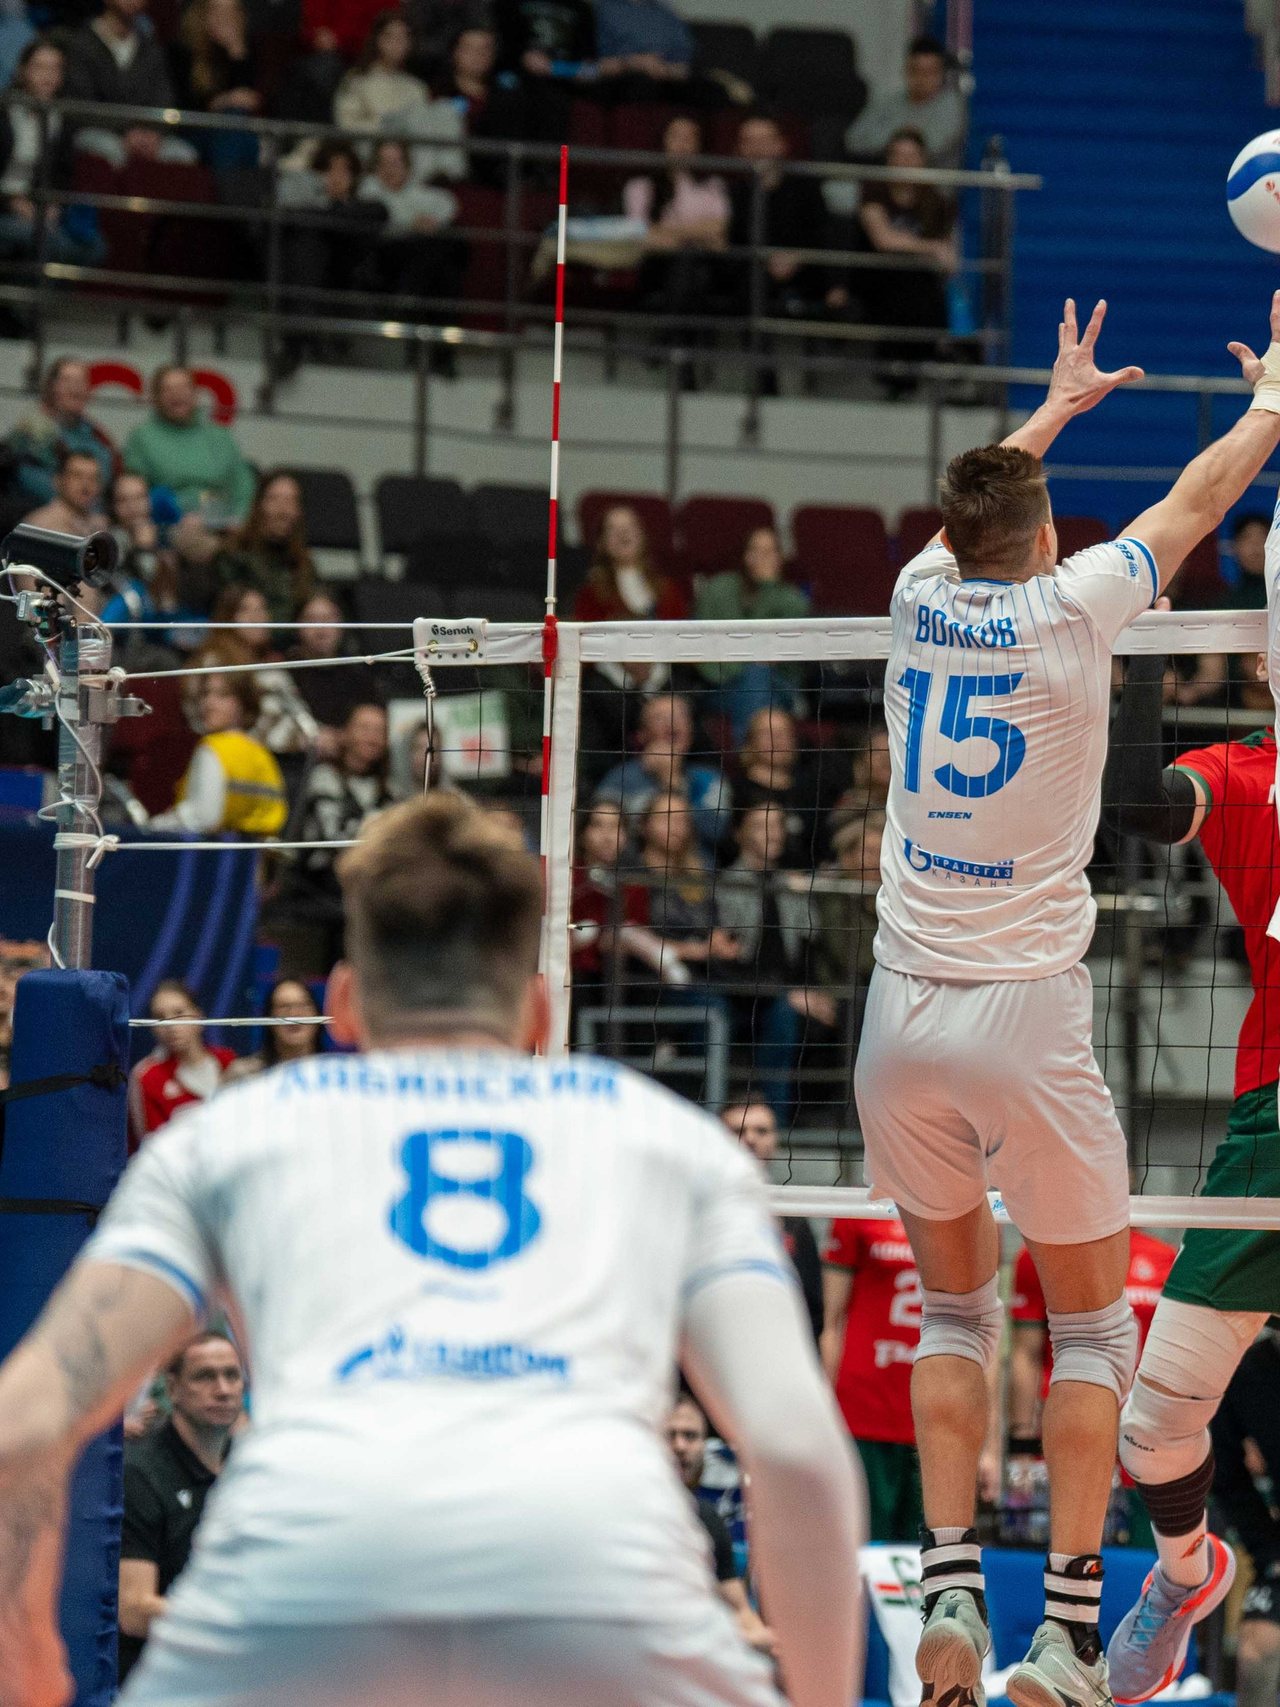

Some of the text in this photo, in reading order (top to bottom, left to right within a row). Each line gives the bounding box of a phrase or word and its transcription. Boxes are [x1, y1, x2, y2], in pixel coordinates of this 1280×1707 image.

[439, 625, 474, 636] Senoh
[915, 604, 1017, 649] ВОЛКОВ
[897, 667, 1026, 798] 15
[927, 811, 973, 820] ENSEN
[934, 856, 1012, 877] ТРАНСГАЗ
[931, 868, 1013, 888] КАЗАНЬ
[387, 1128, 543, 1271] 8
